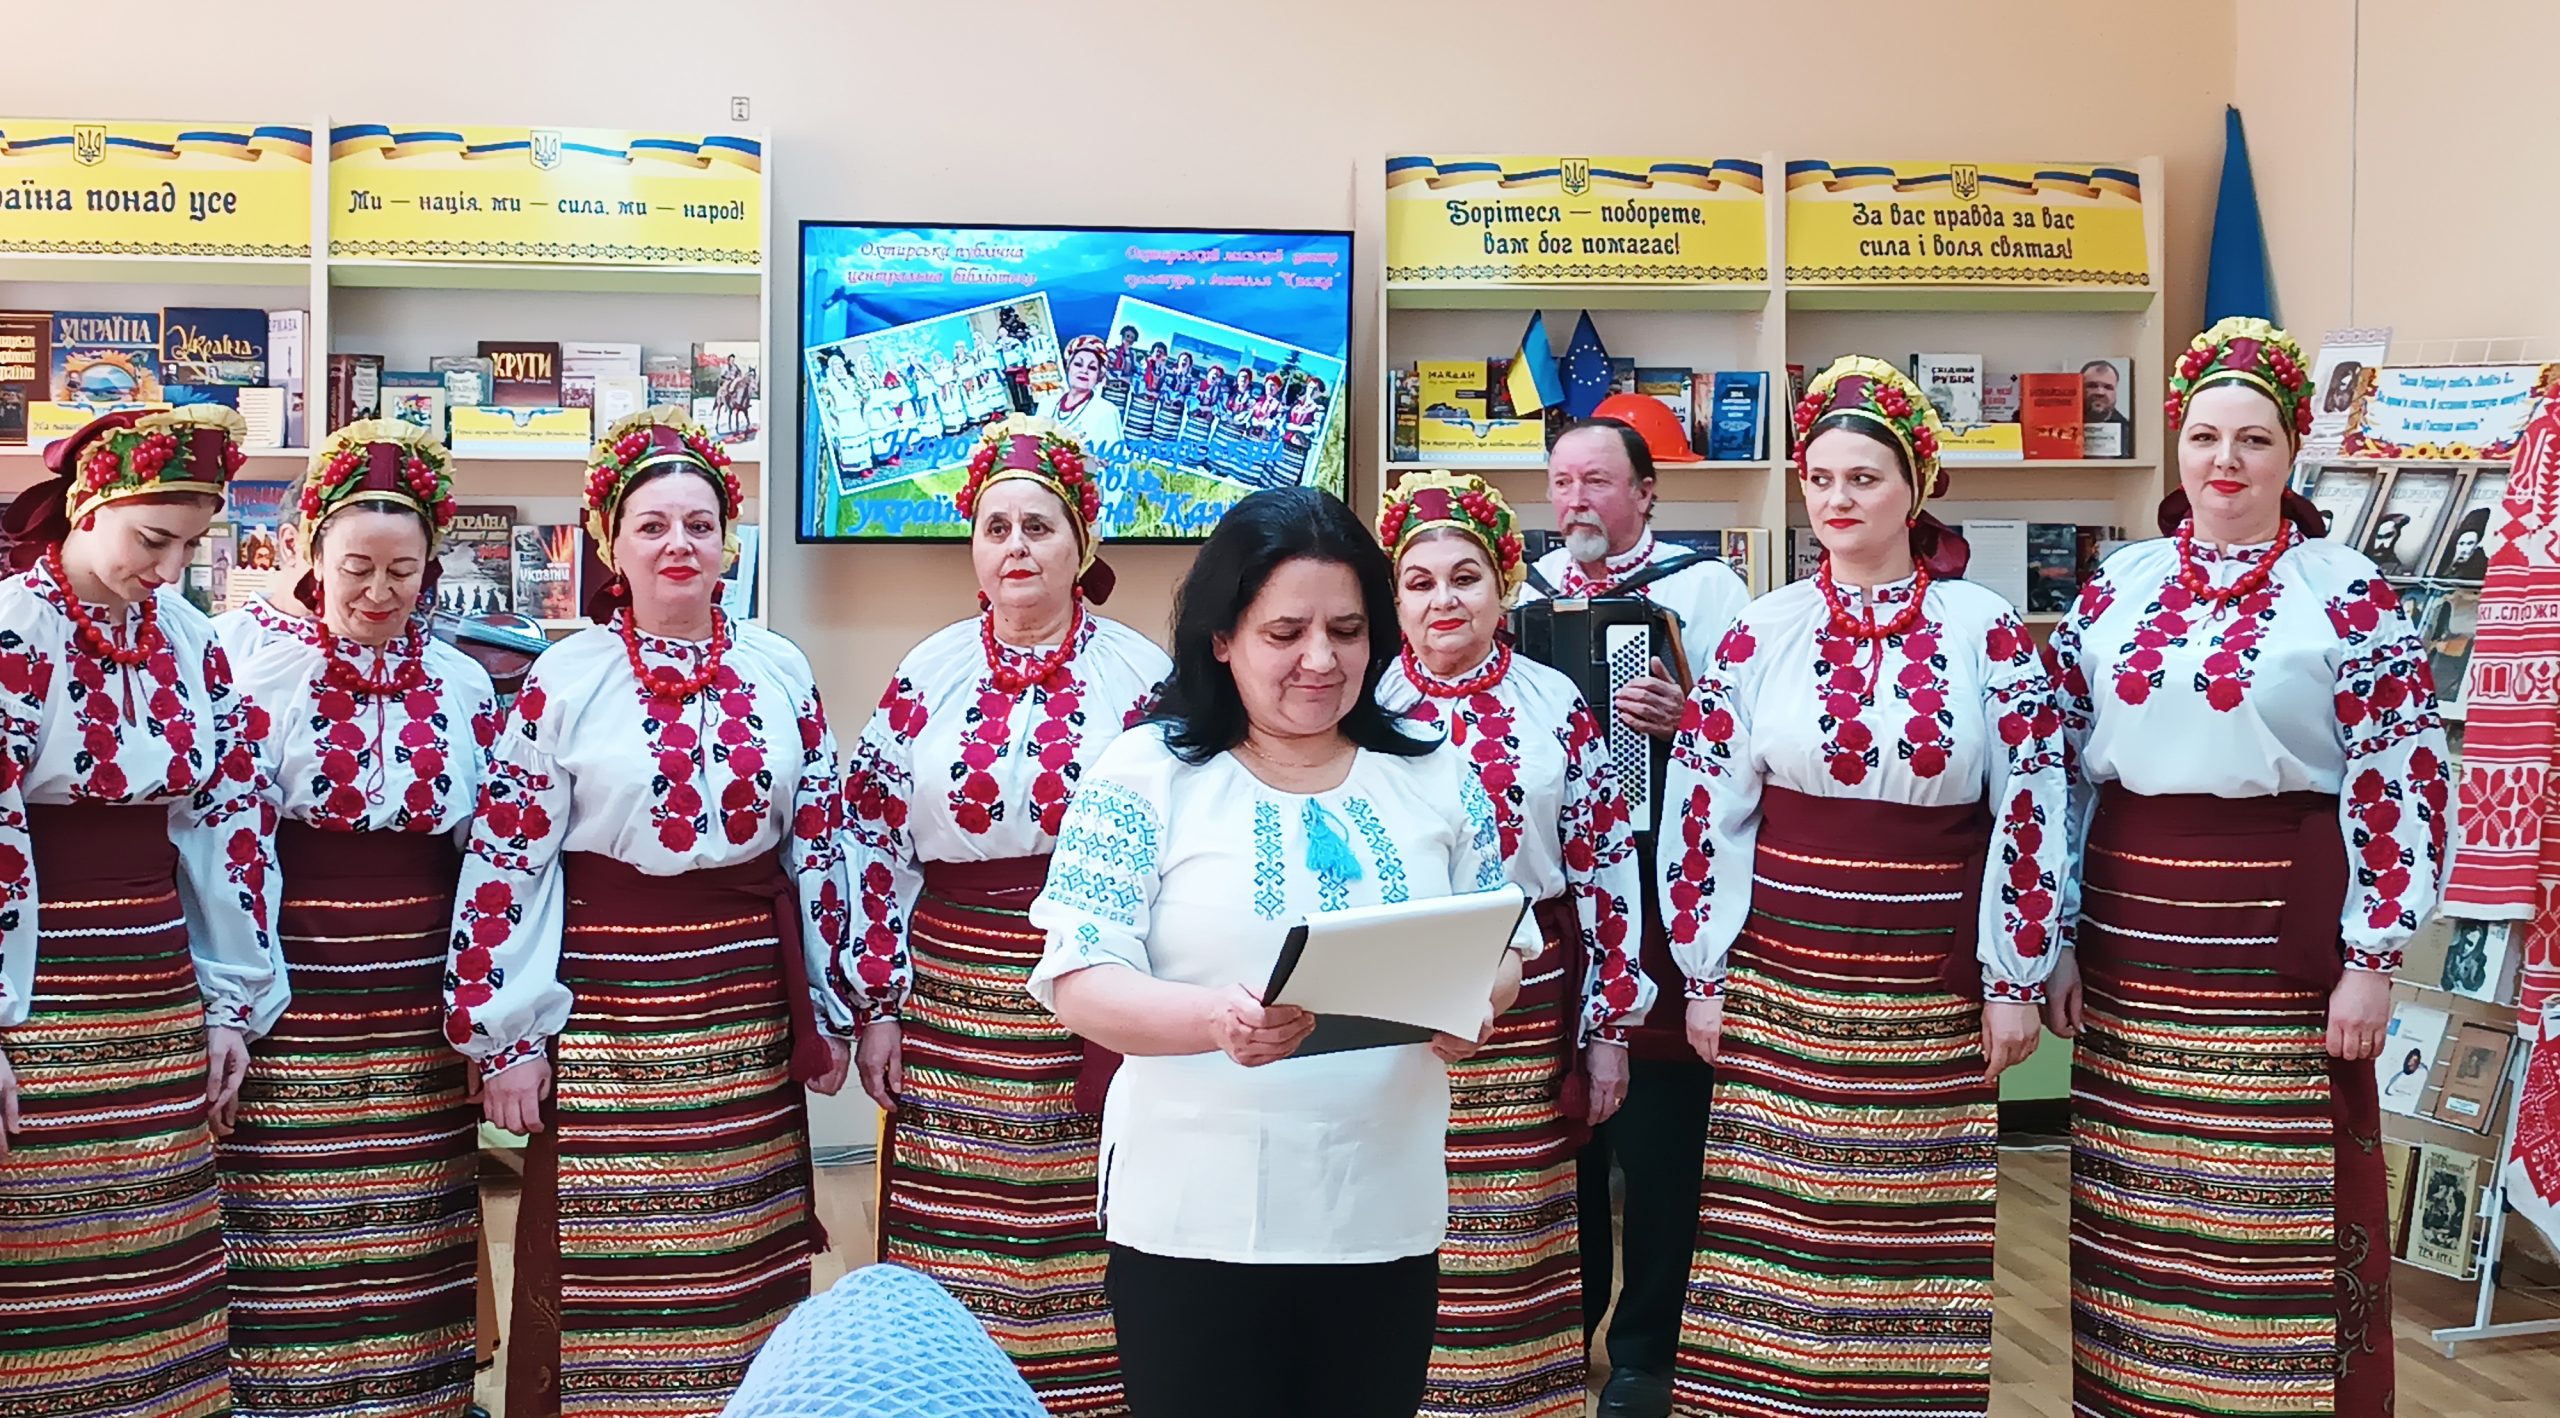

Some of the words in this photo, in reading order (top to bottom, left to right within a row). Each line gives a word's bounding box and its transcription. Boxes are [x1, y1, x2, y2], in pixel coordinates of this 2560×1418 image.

[0, 179, 72, 211] аїна
[86, 181, 176, 213] понад
[189, 190, 237, 222] усе
[348, 190, 382, 213] Ми
[491, 197, 521, 212] ми
[618, 200, 647, 215] ми
[683, 200, 745, 224] народ!
[1447, 199, 1561, 228] Борітеся
[1853, 203, 1883, 226] За
[1891, 204, 1925, 226] вас
[1934, 205, 2005, 231] правда
[2013, 210, 2036, 229] за
[2042, 207, 2075, 230] вас
[861, 242, 949, 261] Охтирська
[955, 242, 1024, 261] публічна
[1538, 230, 1573, 254] бог
[1582, 233, 1680, 256] помагає!
[1860, 239, 1910, 257] сила
[1918, 234, 1926, 256] і
[1933, 235, 1983, 257] воля
[1991, 236, 2073, 260] святая!
[60, 316, 152, 345] УКРАЇНА
[491, 352, 552, 381] КРУТИ
[1932, 375, 1975, 384] РУБІЖ
[877, 426, 978, 469] Наро
